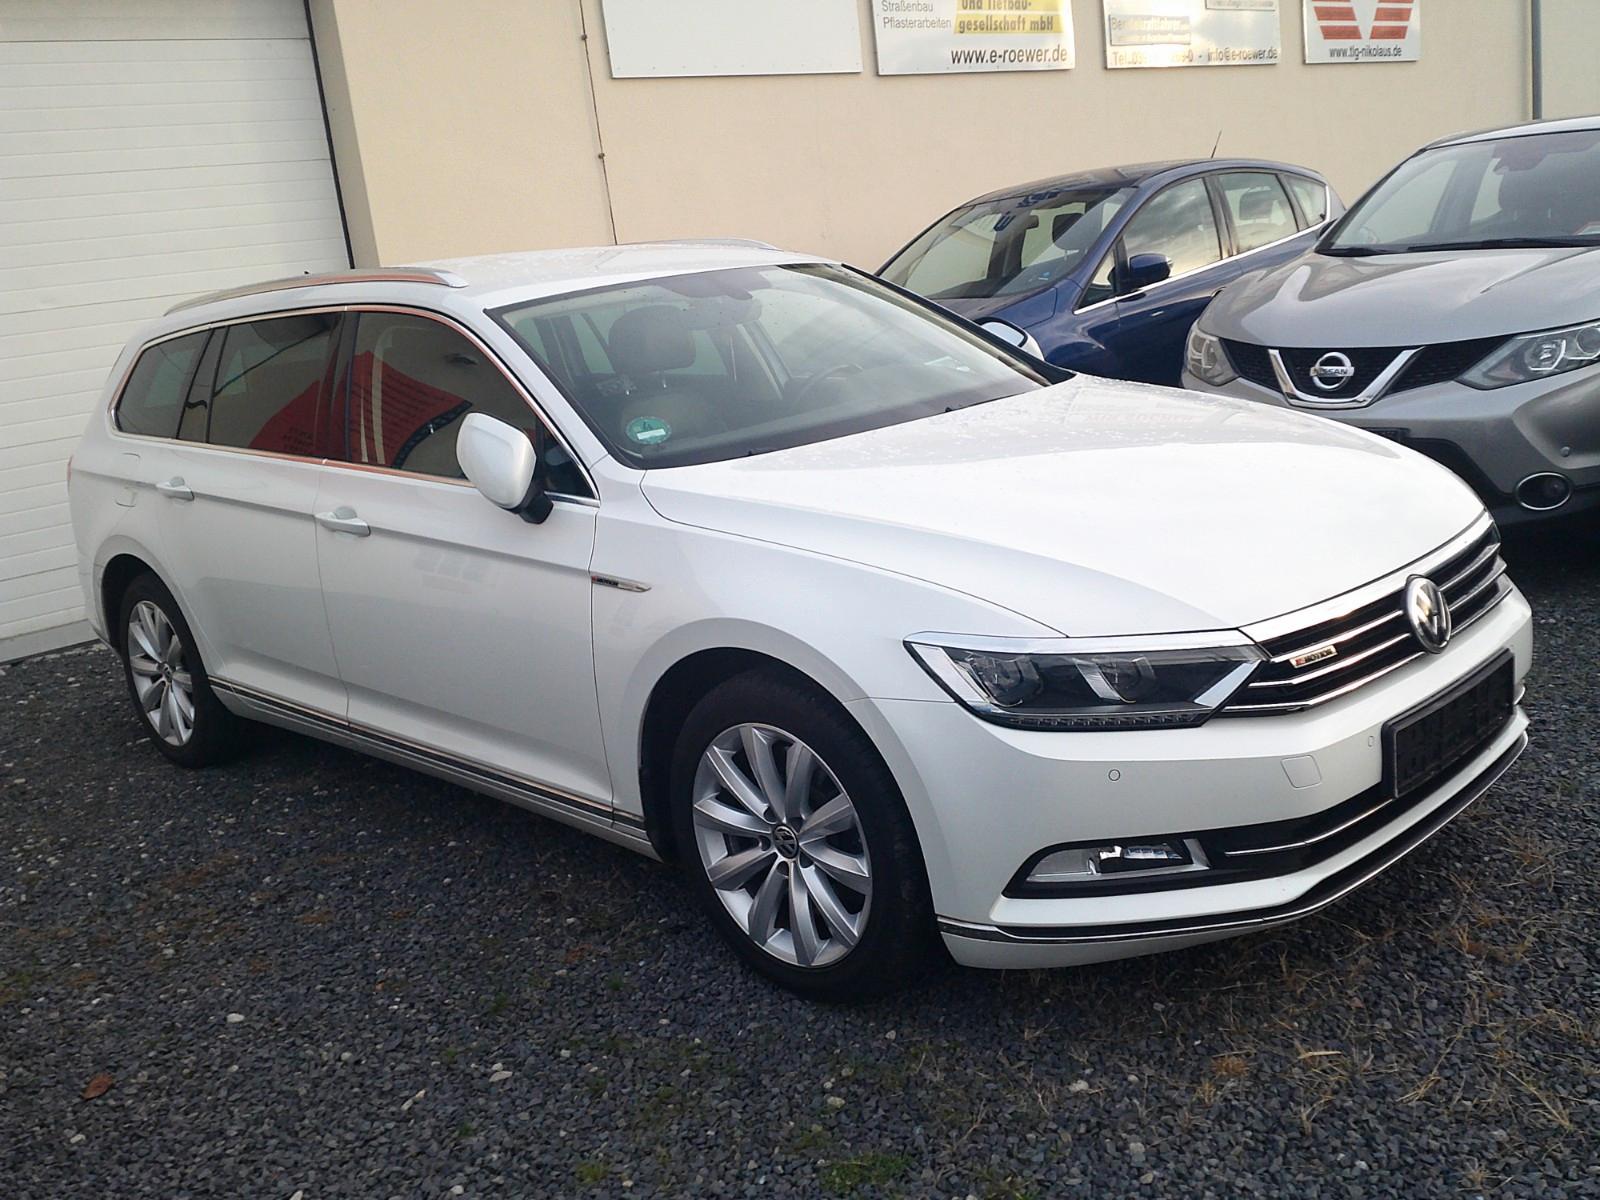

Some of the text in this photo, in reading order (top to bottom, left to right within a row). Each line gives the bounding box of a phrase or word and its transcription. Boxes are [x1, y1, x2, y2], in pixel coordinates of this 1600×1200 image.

[881, 0, 933, 12] Straßenbau
[883, 16, 951, 29] Pflasterarbeiten
[959, 15, 1054, 33] gesellschaft mbH
[951, 44, 1067, 64] www.e-roewer.de
